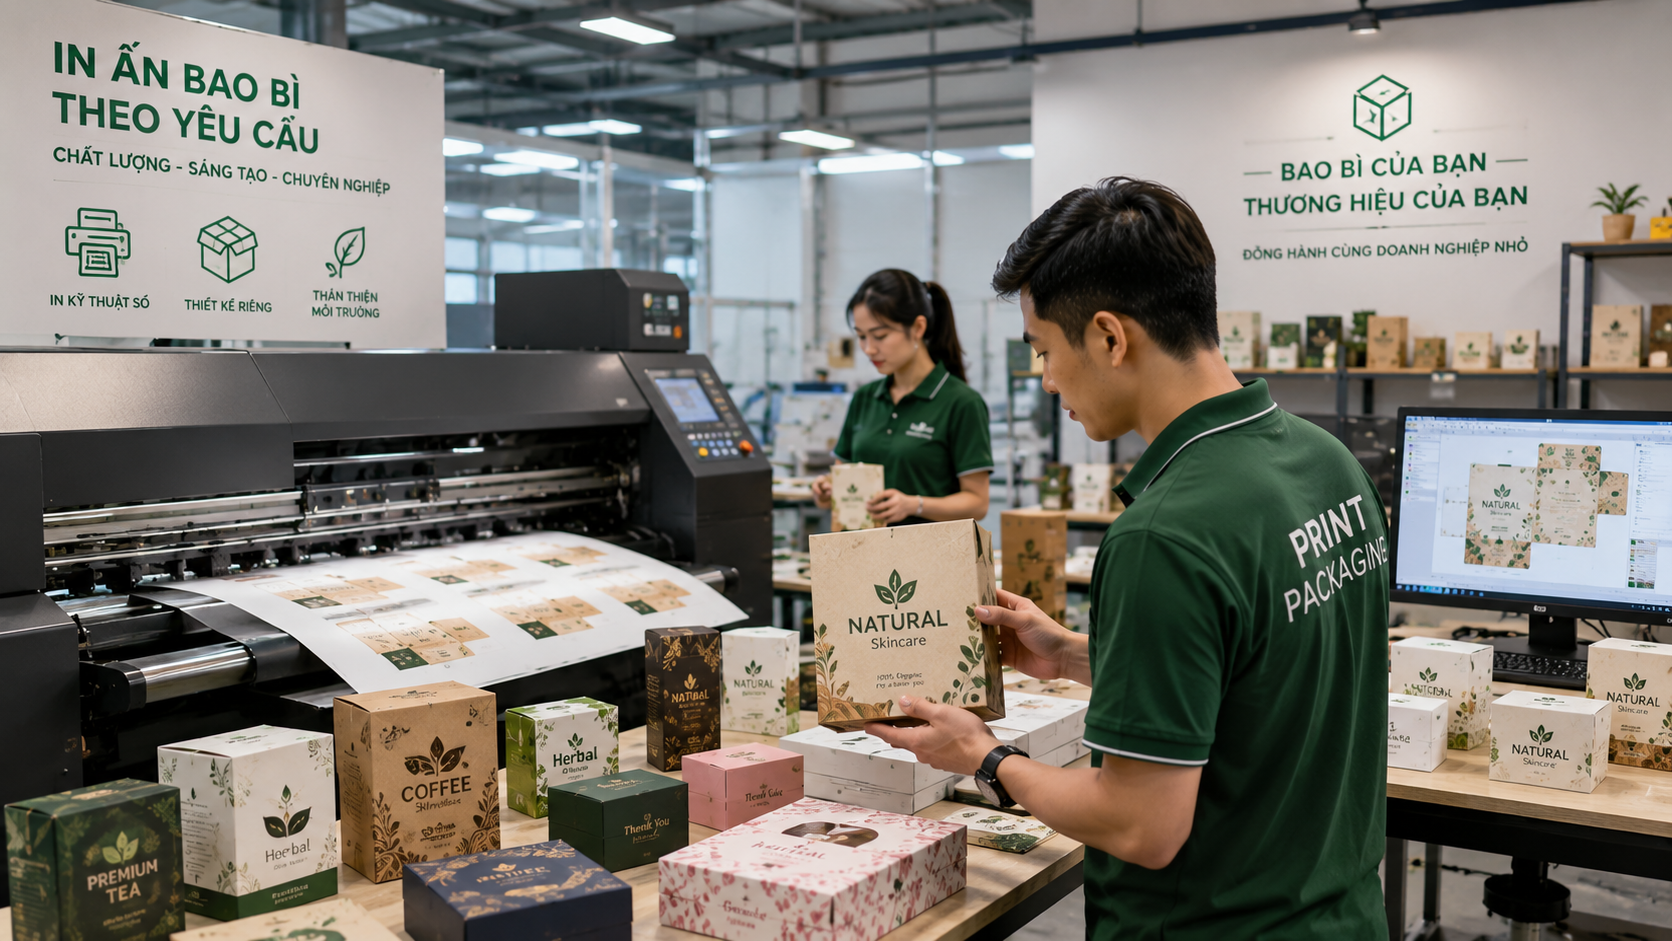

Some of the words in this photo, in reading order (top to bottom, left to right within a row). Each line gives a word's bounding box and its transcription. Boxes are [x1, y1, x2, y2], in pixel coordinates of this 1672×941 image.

[55, 41, 95, 78] IN
[111, 41, 168, 89] ẤN
[184, 63, 258, 102] BAO
[271, 73, 299, 110] BÌ
[52, 91, 160, 134] THEO
[172, 104, 240, 144] YÊU
[188, 159, 232, 179] SÁNG
[237, 167, 267, 184] TẠO
[282, 172, 339, 190] CHUYÊN
[1281, 161, 1332, 181] BAO
[1341, 154, 1362, 178] BÌ
[1372, 150, 1423, 176] CỦA
[1433, 152, 1486, 178] BẠN
[1244, 194, 1342, 216] THƯƠNG
[1350, 188, 1404, 215] HIỆU
[1413, 183, 1465, 209] CỦA
[1474, 186, 1527, 211] BẠN
[1377, 244, 1429, 256] DOANH
[50, 294, 63, 306] IN
[1482, 500, 1520, 510] NATURAL
[1289, 495, 1366, 569] PRINT
[848, 610, 948, 634] NATURAL
[871, 636, 927, 650] Skincare
[733, 678, 774, 689] NATURAL
[1606, 692, 1660, 707] NATURAL
[553, 746, 598, 768] Herbal
[1512, 744, 1569, 761] NATURAL
[402, 776, 471, 802] COFFEE
[86, 858, 158, 891] PREMIUM
[105, 885, 141, 904] TEA
